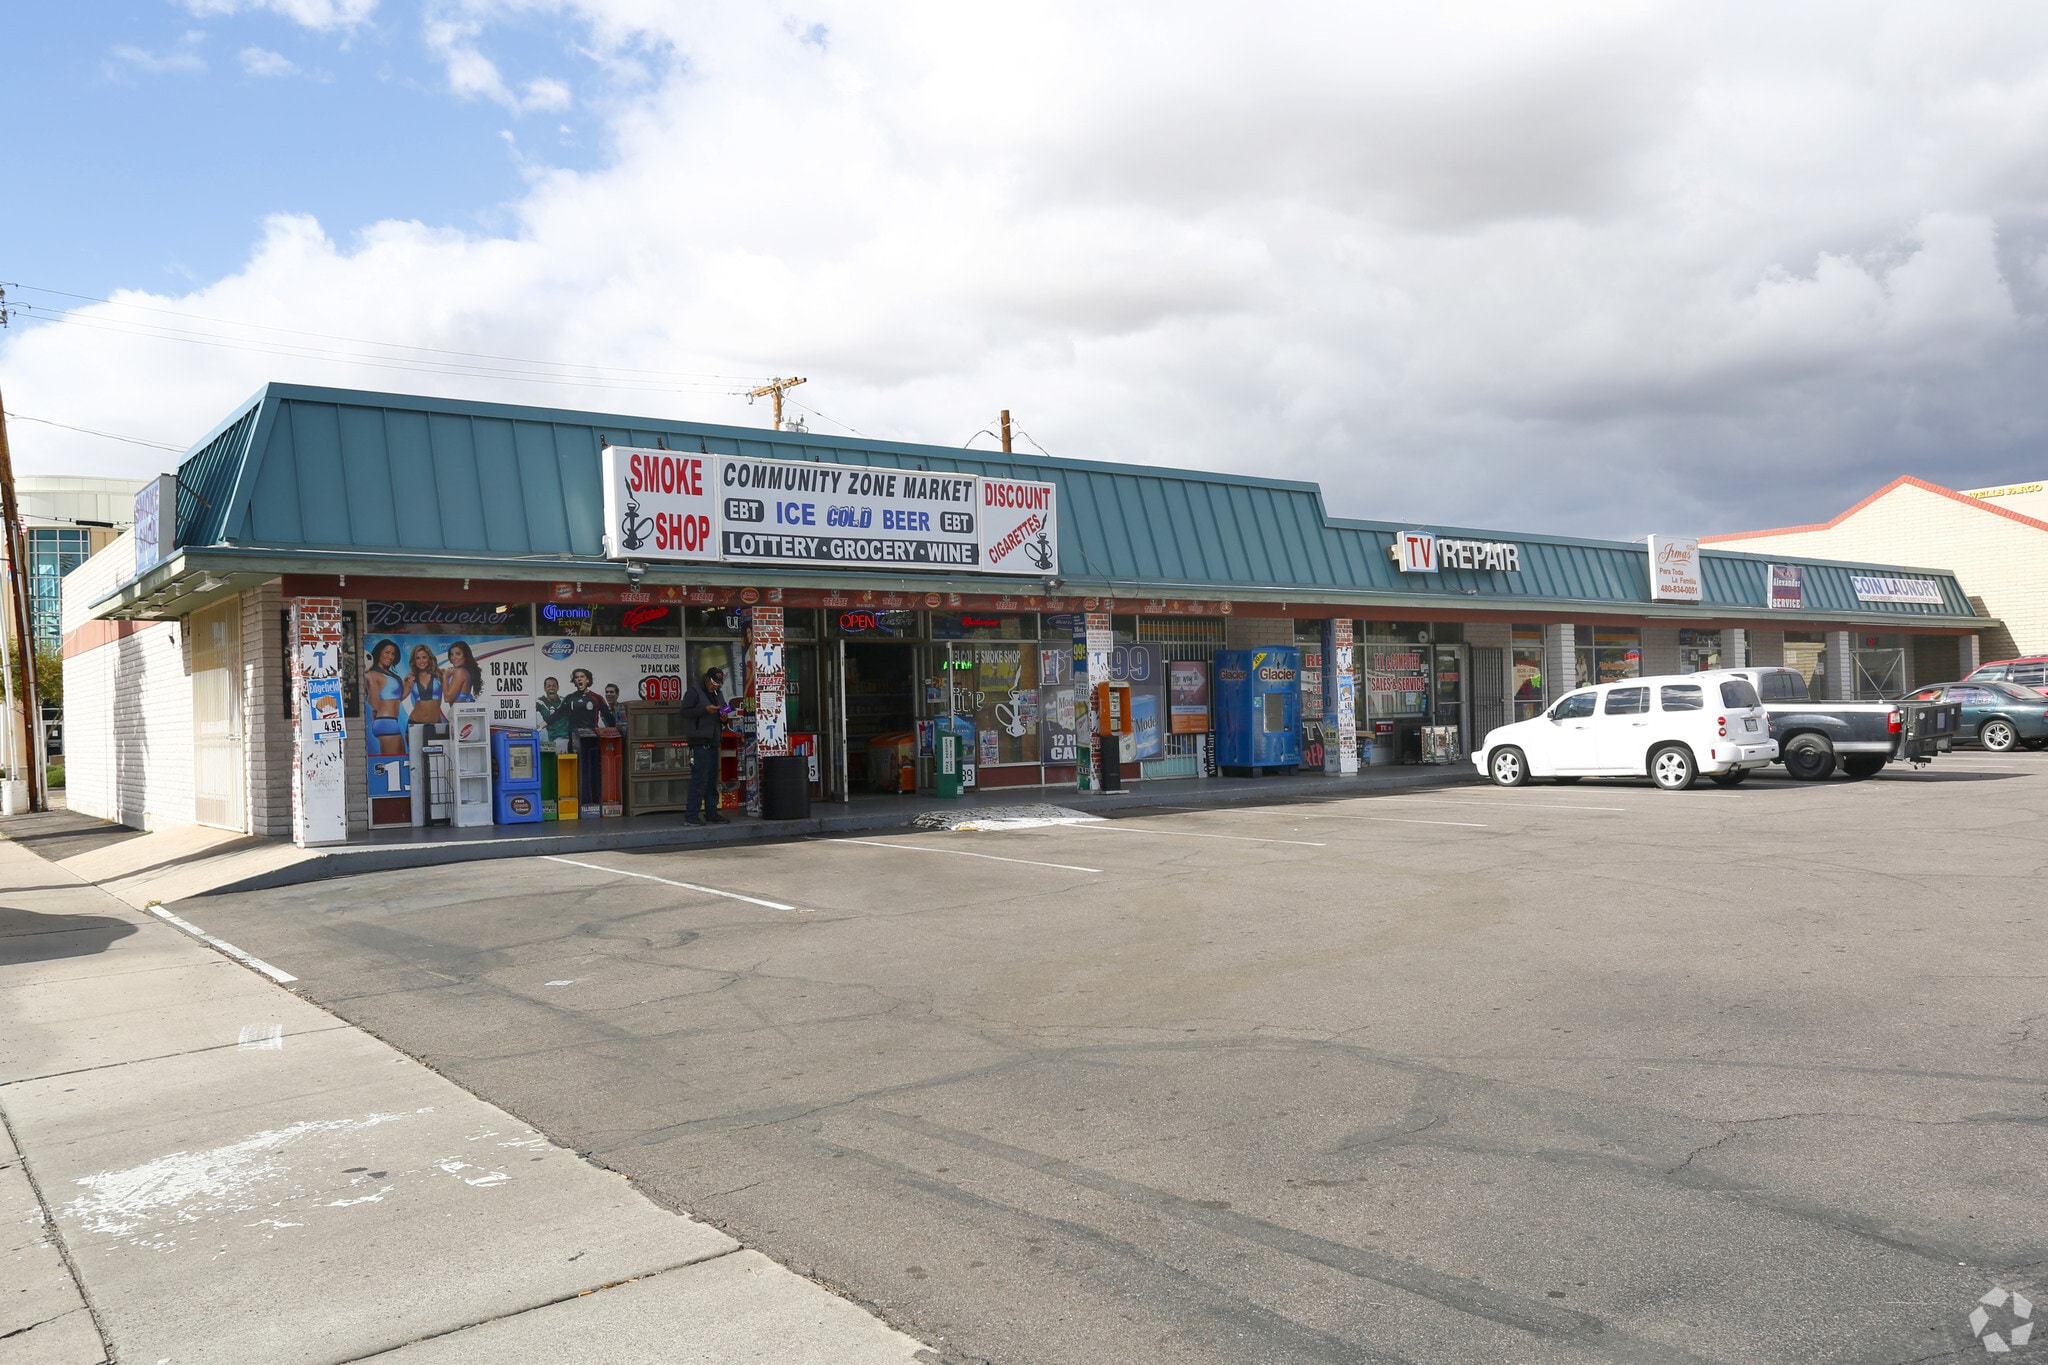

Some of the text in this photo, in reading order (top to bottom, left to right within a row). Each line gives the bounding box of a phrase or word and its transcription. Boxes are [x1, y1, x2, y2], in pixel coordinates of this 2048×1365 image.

[630, 454, 703, 496] SMOKE
[724, 463, 972, 502] COMMUNITY ZONE MARKET
[985, 483, 1050, 510] DISCOUNT
[2007, 484, 2043, 496] FARGO
[730, 501, 969, 531] EBT ICE COLD BEER EBT
[655, 512, 710, 551] SHOP
[988, 513, 1041, 564] CIGARETTES
[729, 533, 973, 563] LOTTERY GROCERY WINE
[1407, 537, 1520, 572] TV REPAIR
[1672, 568, 1684, 576] Toda
[1773, 577, 1801, 587] Alexander
[1852, 577, 1938, 597] COIN LAUNDRY
[1772, 598, 1800, 608] SERVICE
[366, 602, 515, 626] Budweiser
[543, 604, 592, 622] Coronita
[558, 618, 581, 627] Extra
[840, 614, 875, 628] OPEN
[635, 644, 651, 653] CON
[653, 644, 662, 653] EL
[981, 650, 1003, 664] SMOKE
[1004, 650, 1021, 664] SHOP
[1391, 653, 1420, 671] COMPUTER
[490, 662, 528, 676] 18 PACK
[640, 664, 680, 673] 12 PACK CANS
[1219, 669, 1247, 680] Glacier
[1259, 668, 1297, 681] Glacier
[309, 680, 340, 695] Edgefield
[496, 678, 523, 692] CANS
[757, 676, 782, 685] TECATE
[1371, 677, 1392, 691] SALES
[1392, 678, 1397, 691] &
[1398, 676, 1425, 691] SERVICE
[500, 699, 520, 709] BUD &
[494, 710, 527, 720] BUD LIGHT
[324, 720, 342, 732] 4.95
[1052, 735, 1065, 746] 12
